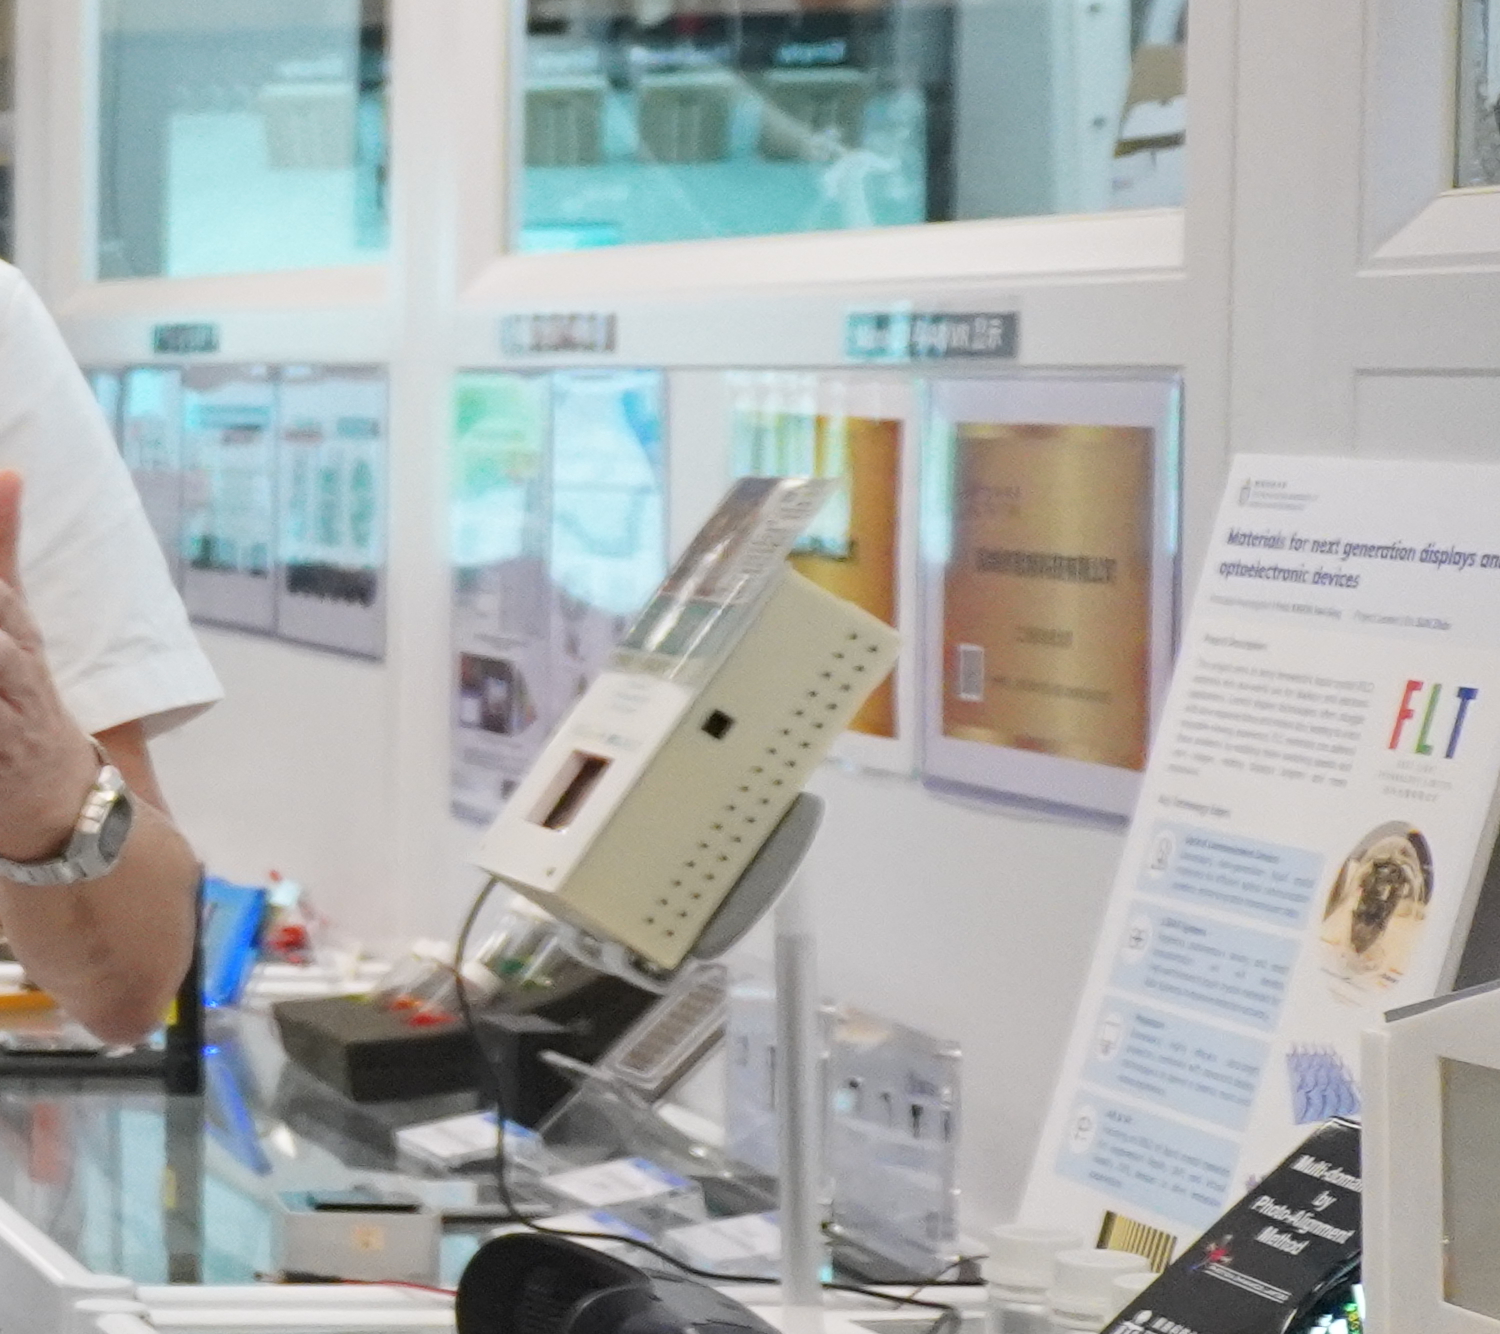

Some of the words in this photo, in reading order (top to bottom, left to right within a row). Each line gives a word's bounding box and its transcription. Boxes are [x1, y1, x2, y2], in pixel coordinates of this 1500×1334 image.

[1227, 527, 1285, 549] Materials
[1290, 532, 1310, 551] for
[1311, 536, 1339, 553] next
[1343, 540, 1416, 562] generation
[1419, 543, 1477, 571] displays
[1480, 553, 1500, 569] an
[1219, 560, 1308, 585] optoelectronic
[1312, 566, 1360, 589] devices
[1388, 679, 1479, 759] FLT
[1311, 1190, 1337, 1212] by
[1251, 1195, 1355, 1244] Photo-Alignment
[1255, 1226, 1310, 1255] Method
